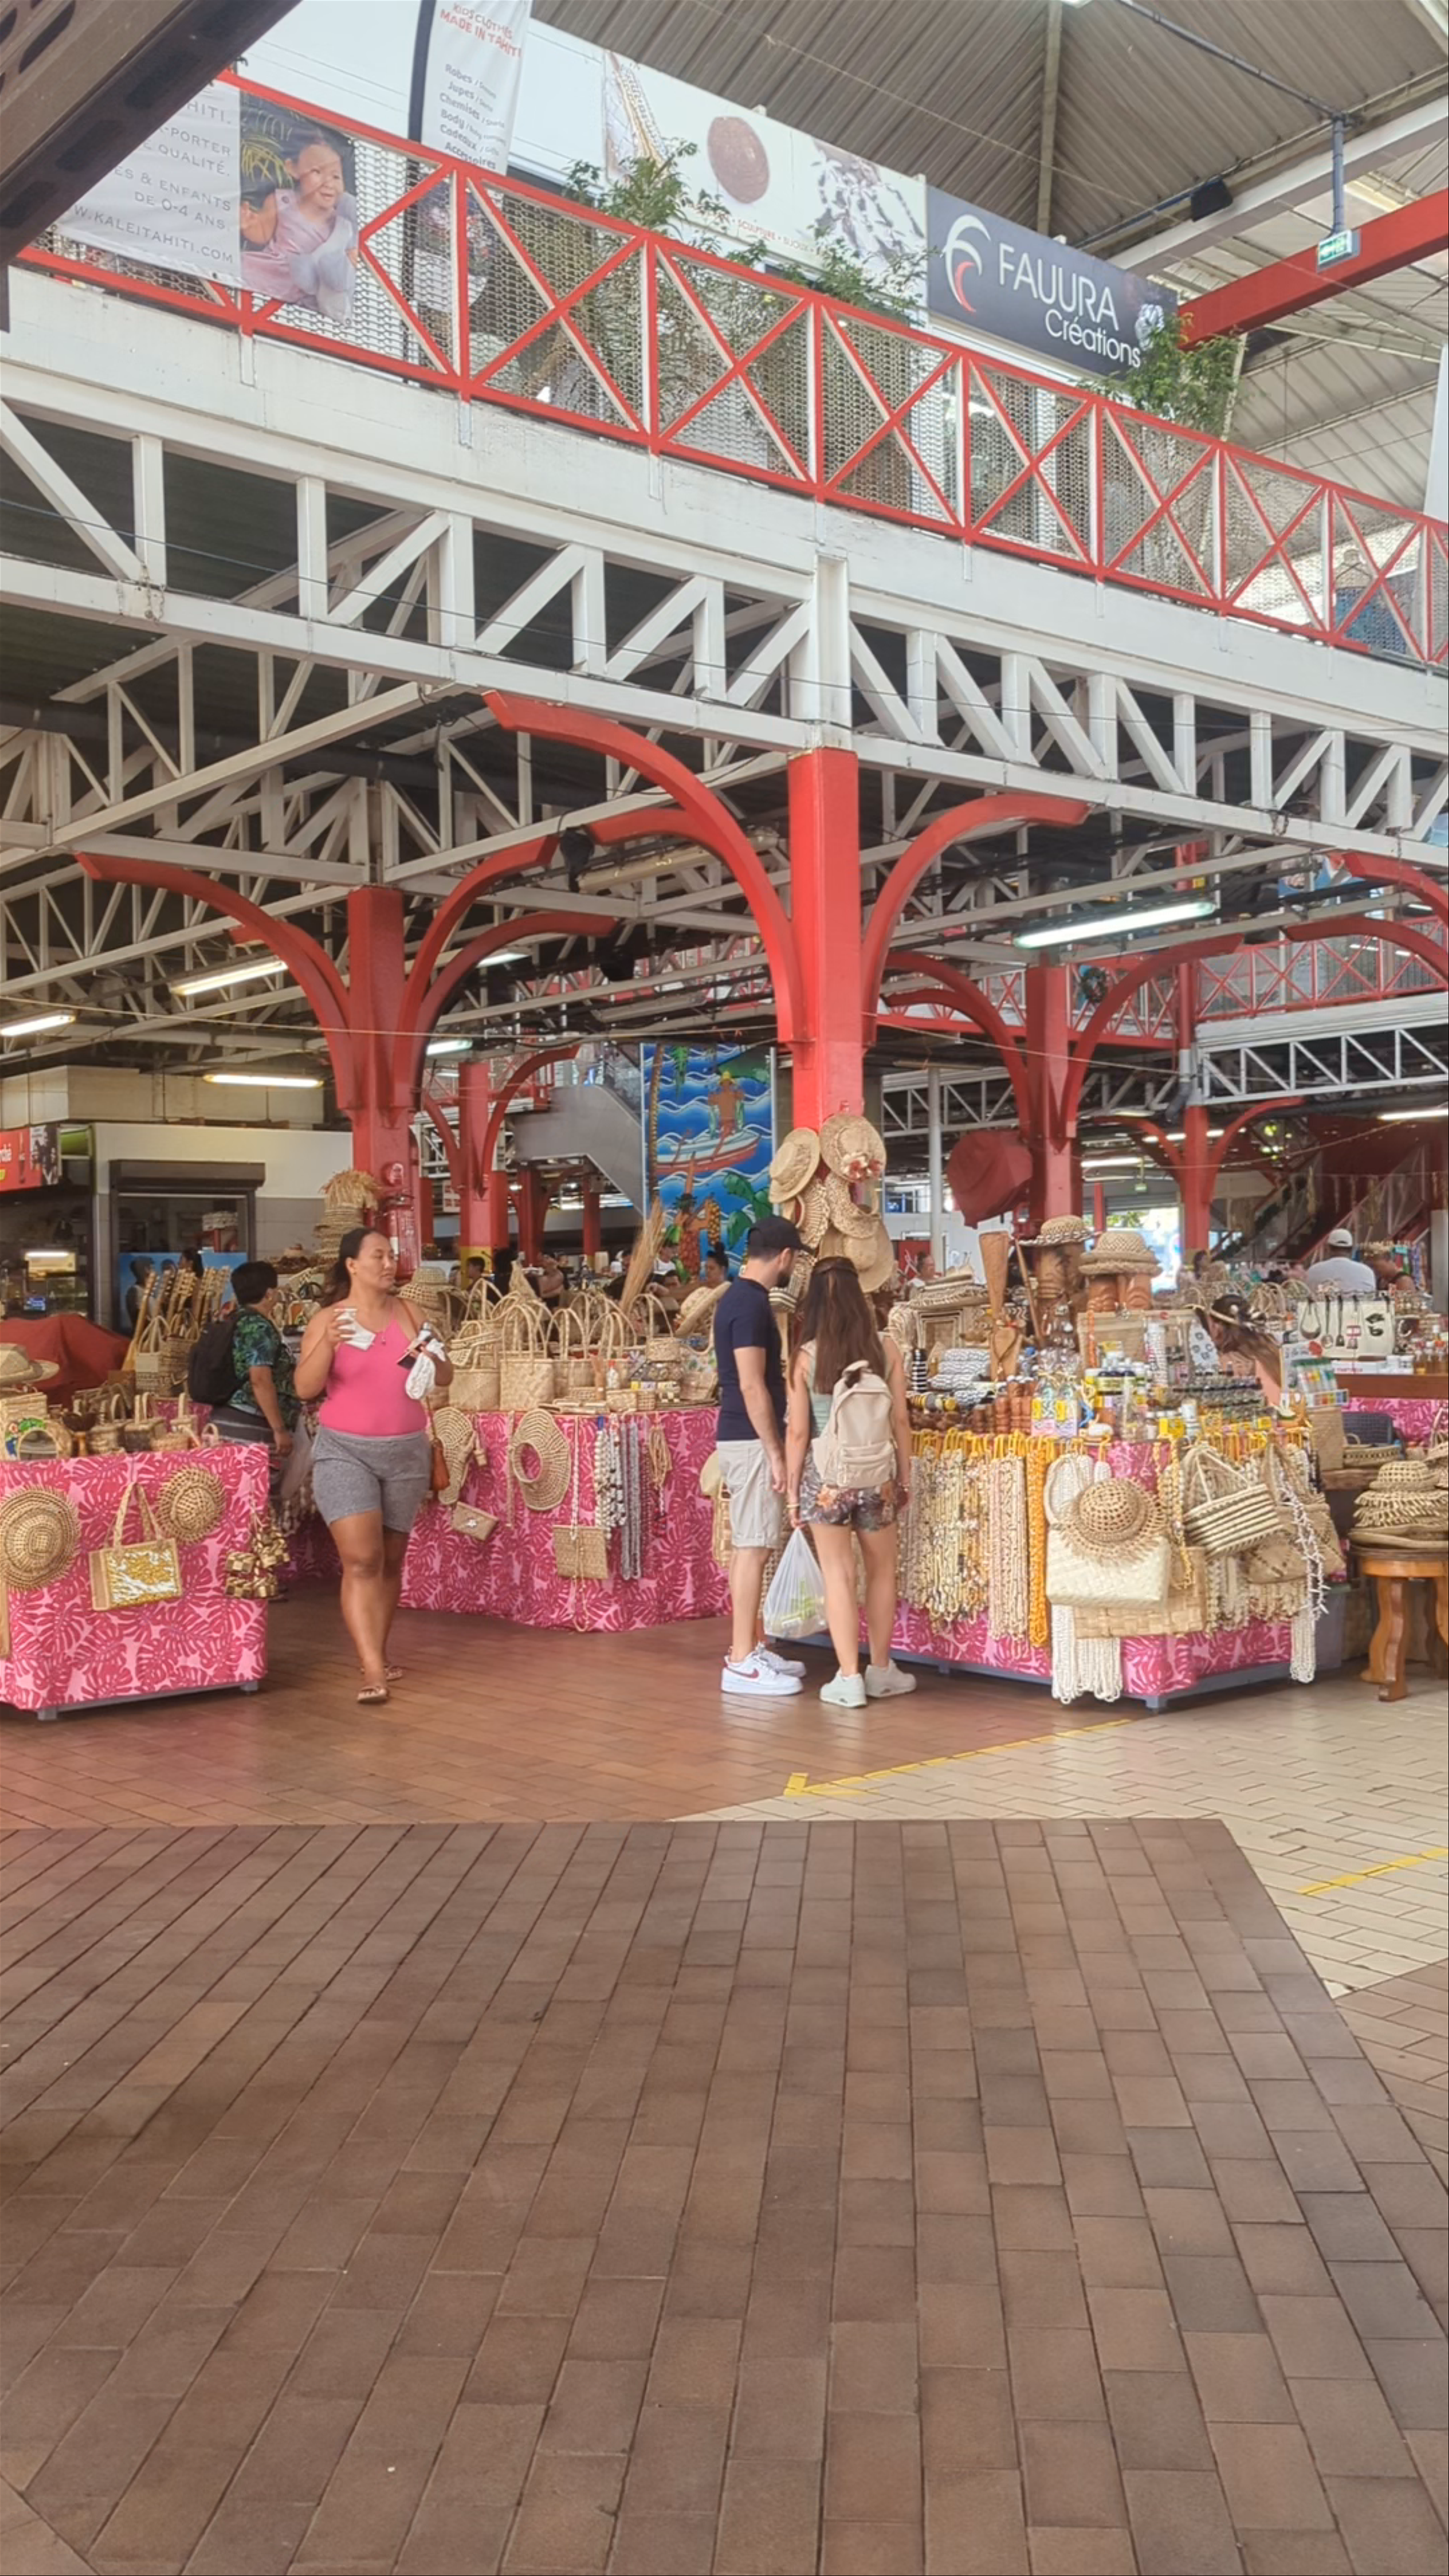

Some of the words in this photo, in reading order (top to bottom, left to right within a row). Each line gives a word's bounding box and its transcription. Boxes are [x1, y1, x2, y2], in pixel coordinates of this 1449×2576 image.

[440, 9, 472, 33] MADE
[475, 26, 486, 40] IN
[488, 33, 521, 57] TAHITI
[445, 63, 472, 83] Robes
[448, 82, 474, 99] Jupes
[187, 100, 231, 125] HITI.
[440, 92, 480, 120] Chemises
[441, 109, 465, 130] Body
[160, 126, 231, 156] -PORTER
[440, 124, 476, 151] Cadeaux
[134, 191, 155, 206] DE
[141, 172, 153, 186] &
[160, 180, 231, 212] ENFANTS
[74, 205, 233, 263] W.KALEITAHITI.COM
[999, 243, 1119, 331] FAUURA
[1045, 309, 1141, 368] Créations
